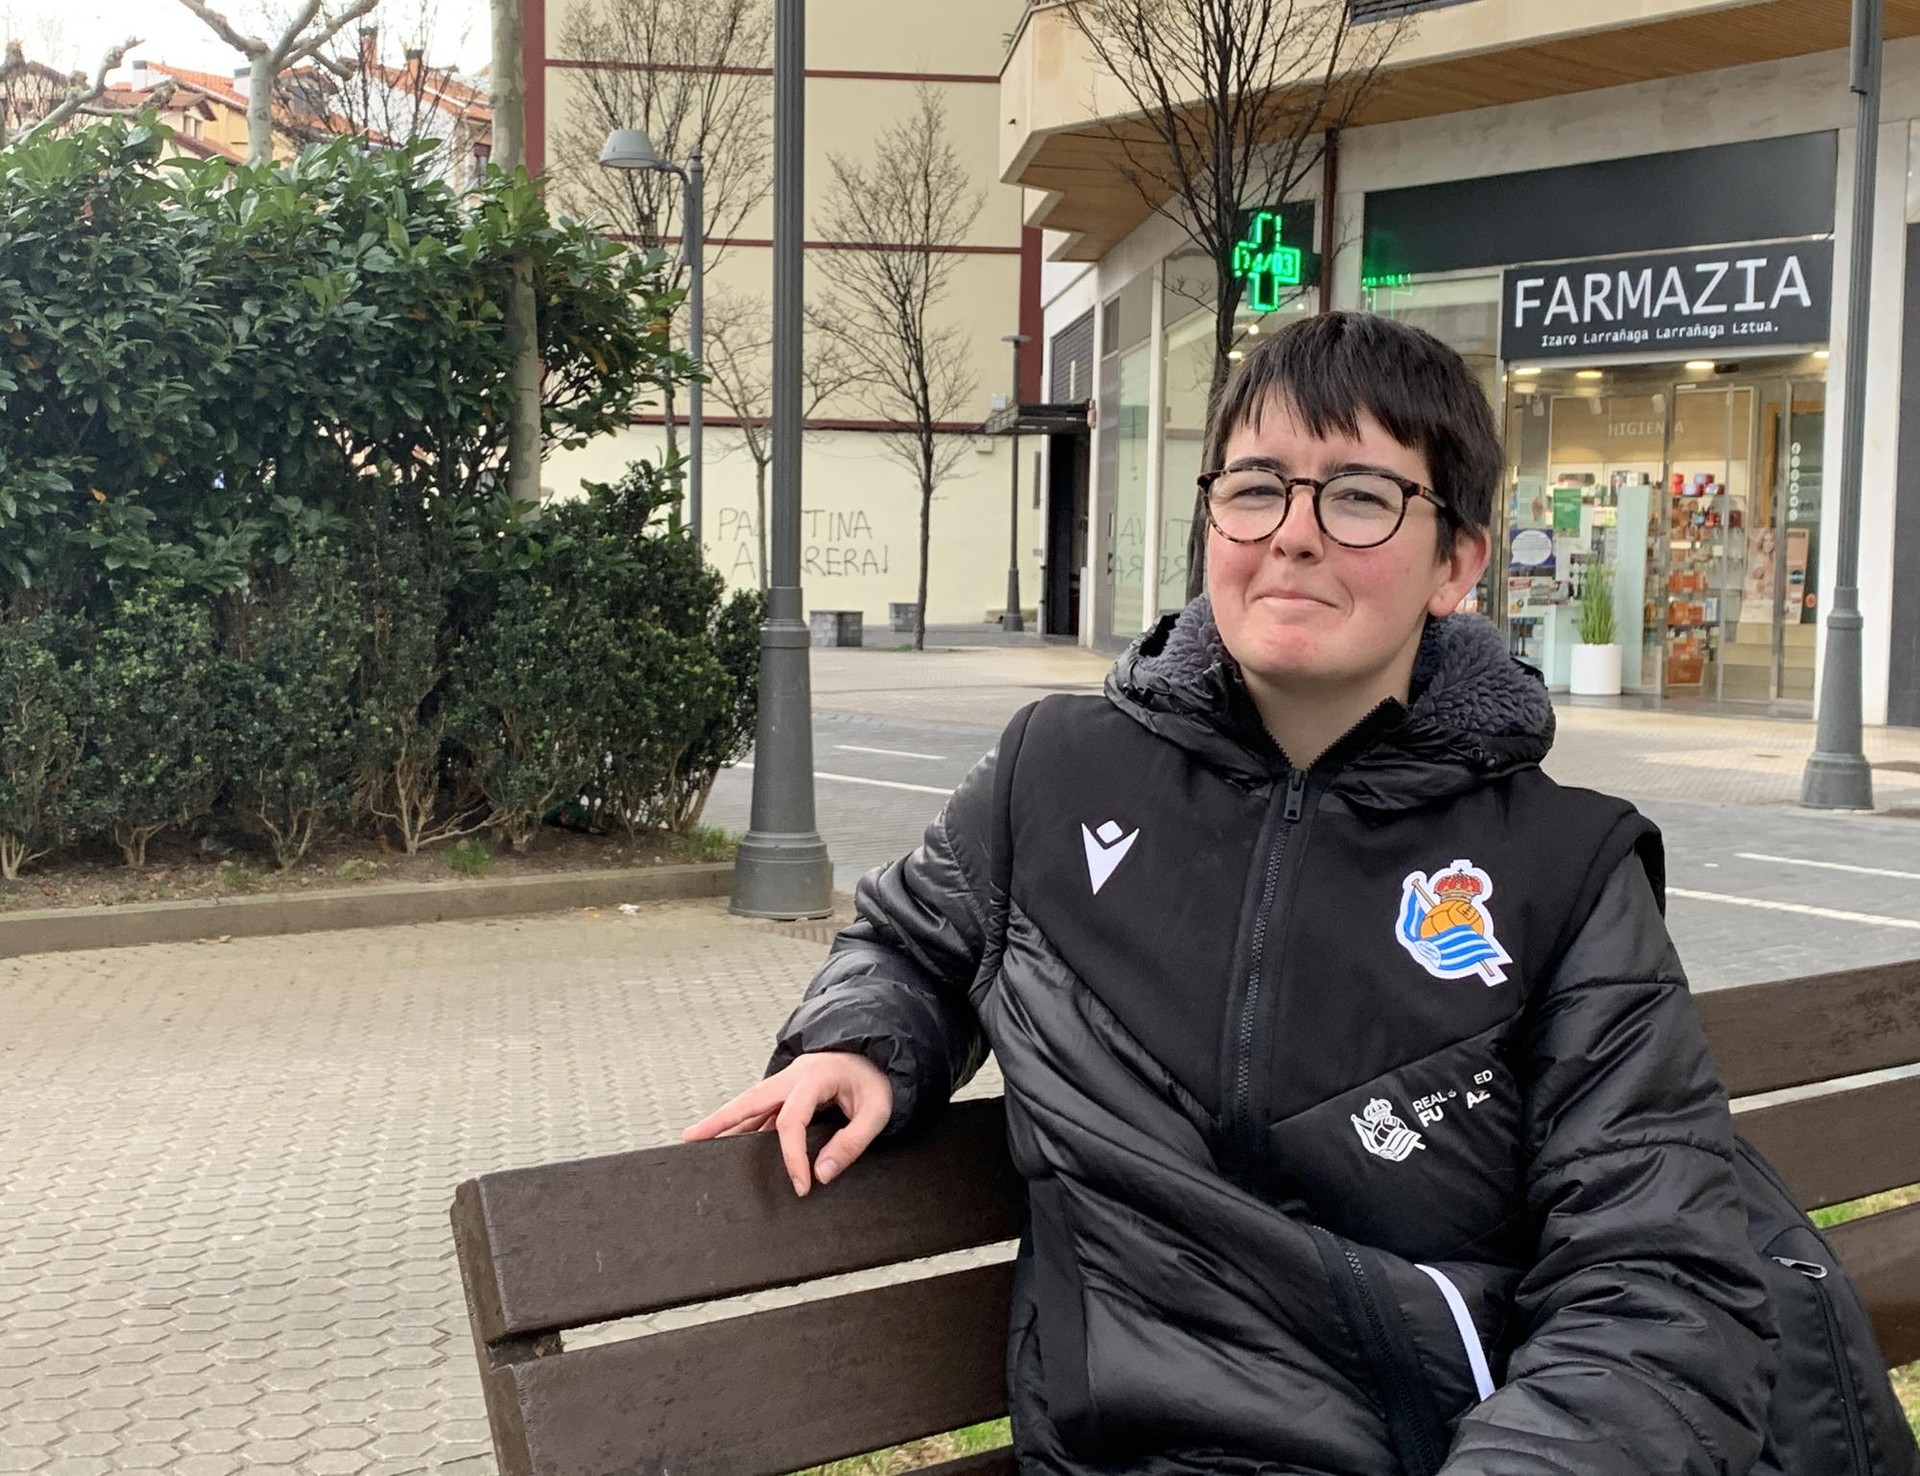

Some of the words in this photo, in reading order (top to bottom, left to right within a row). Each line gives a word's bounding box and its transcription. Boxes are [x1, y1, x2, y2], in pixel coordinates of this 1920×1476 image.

[1515, 255, 1812, 328] FARMAZIA
[1541, 334, 1577, 347] Izaro
[1583, 328, 1649, 344] Larrañaga
[1656, 323, 1725, 339] Larrañaga
[1608, 420, 1684, 437] HIGIENA
[718, 507, 873, 541] PATINA
[1412, 1091, 1448, 1113] REAL
